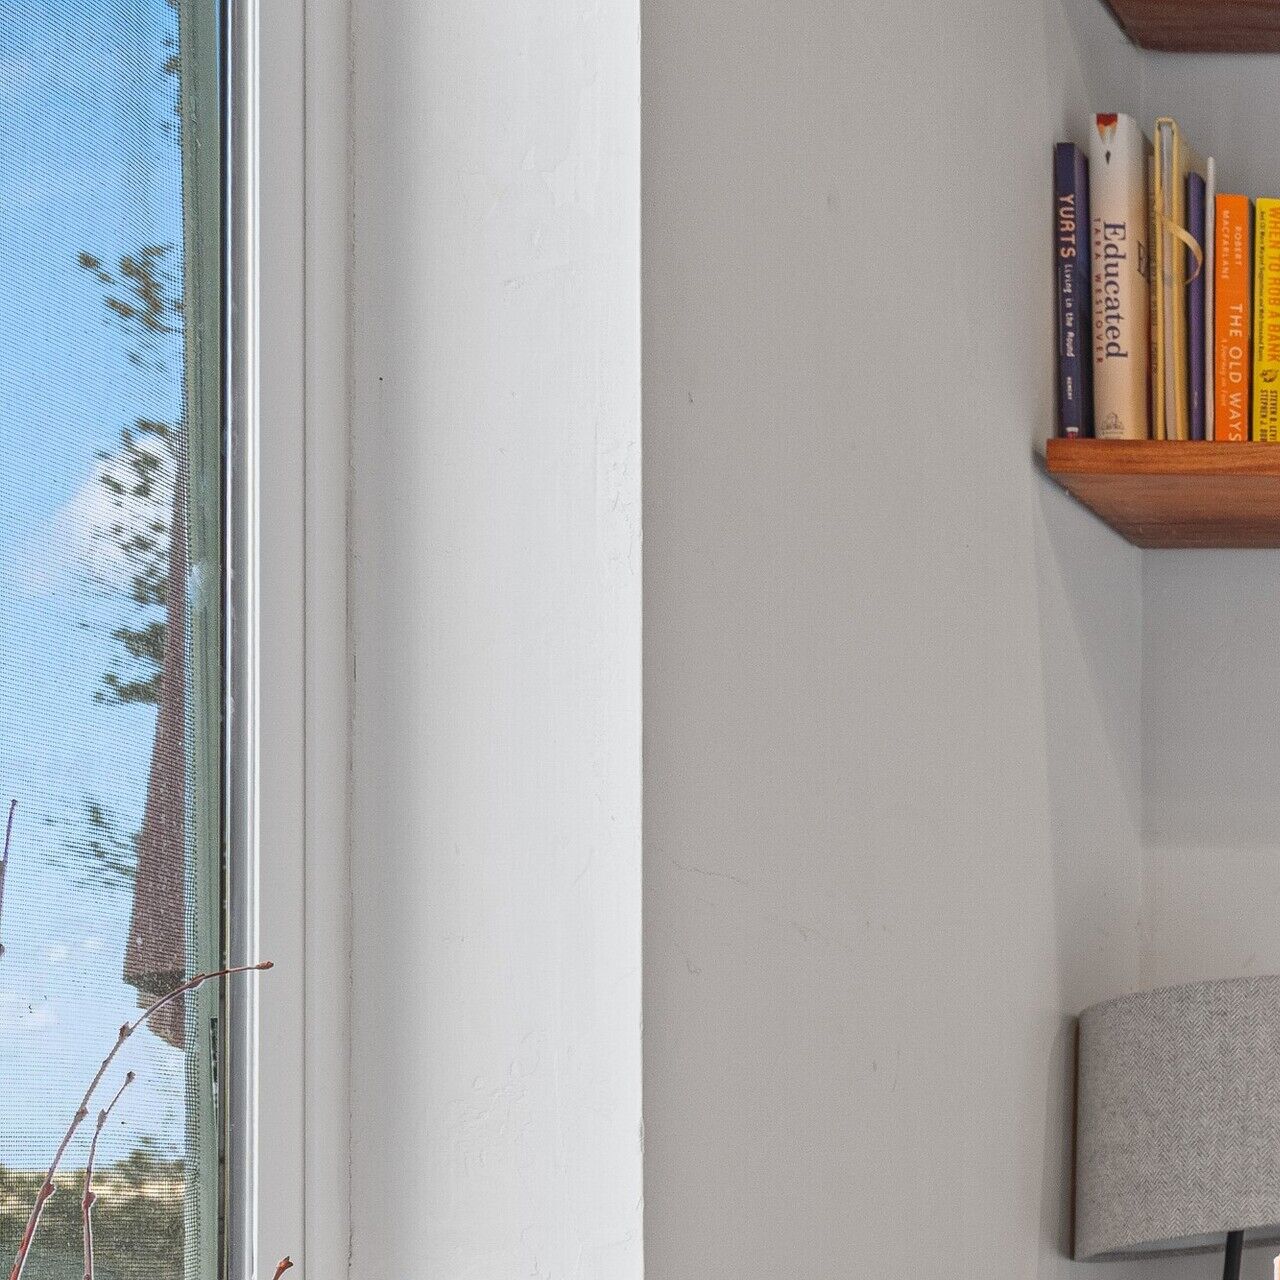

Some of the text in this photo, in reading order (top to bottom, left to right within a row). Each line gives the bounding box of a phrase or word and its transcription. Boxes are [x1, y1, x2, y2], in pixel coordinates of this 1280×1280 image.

[1059, 194, 1076, 258] YURTS
[1221, 209, 1231, 280] MACFARLANE
[1233, 226, 1243, 266] ROBERT
[1063, 264, 1077, 357] Living in the Round
[1094, 218, 1105, 365] TARA WESTOVER
[1103, 222, 1129, 360] Educated
[1228, 303, 1244, 441] THE OLD WAYS
[1259, 388, 1269, 418] STEPHEN
[1269, 389, 1278, 416] STEVEN
[1259, 428, 1268, 442] DUB
[1268, 425, 1278, 440] LEVI
